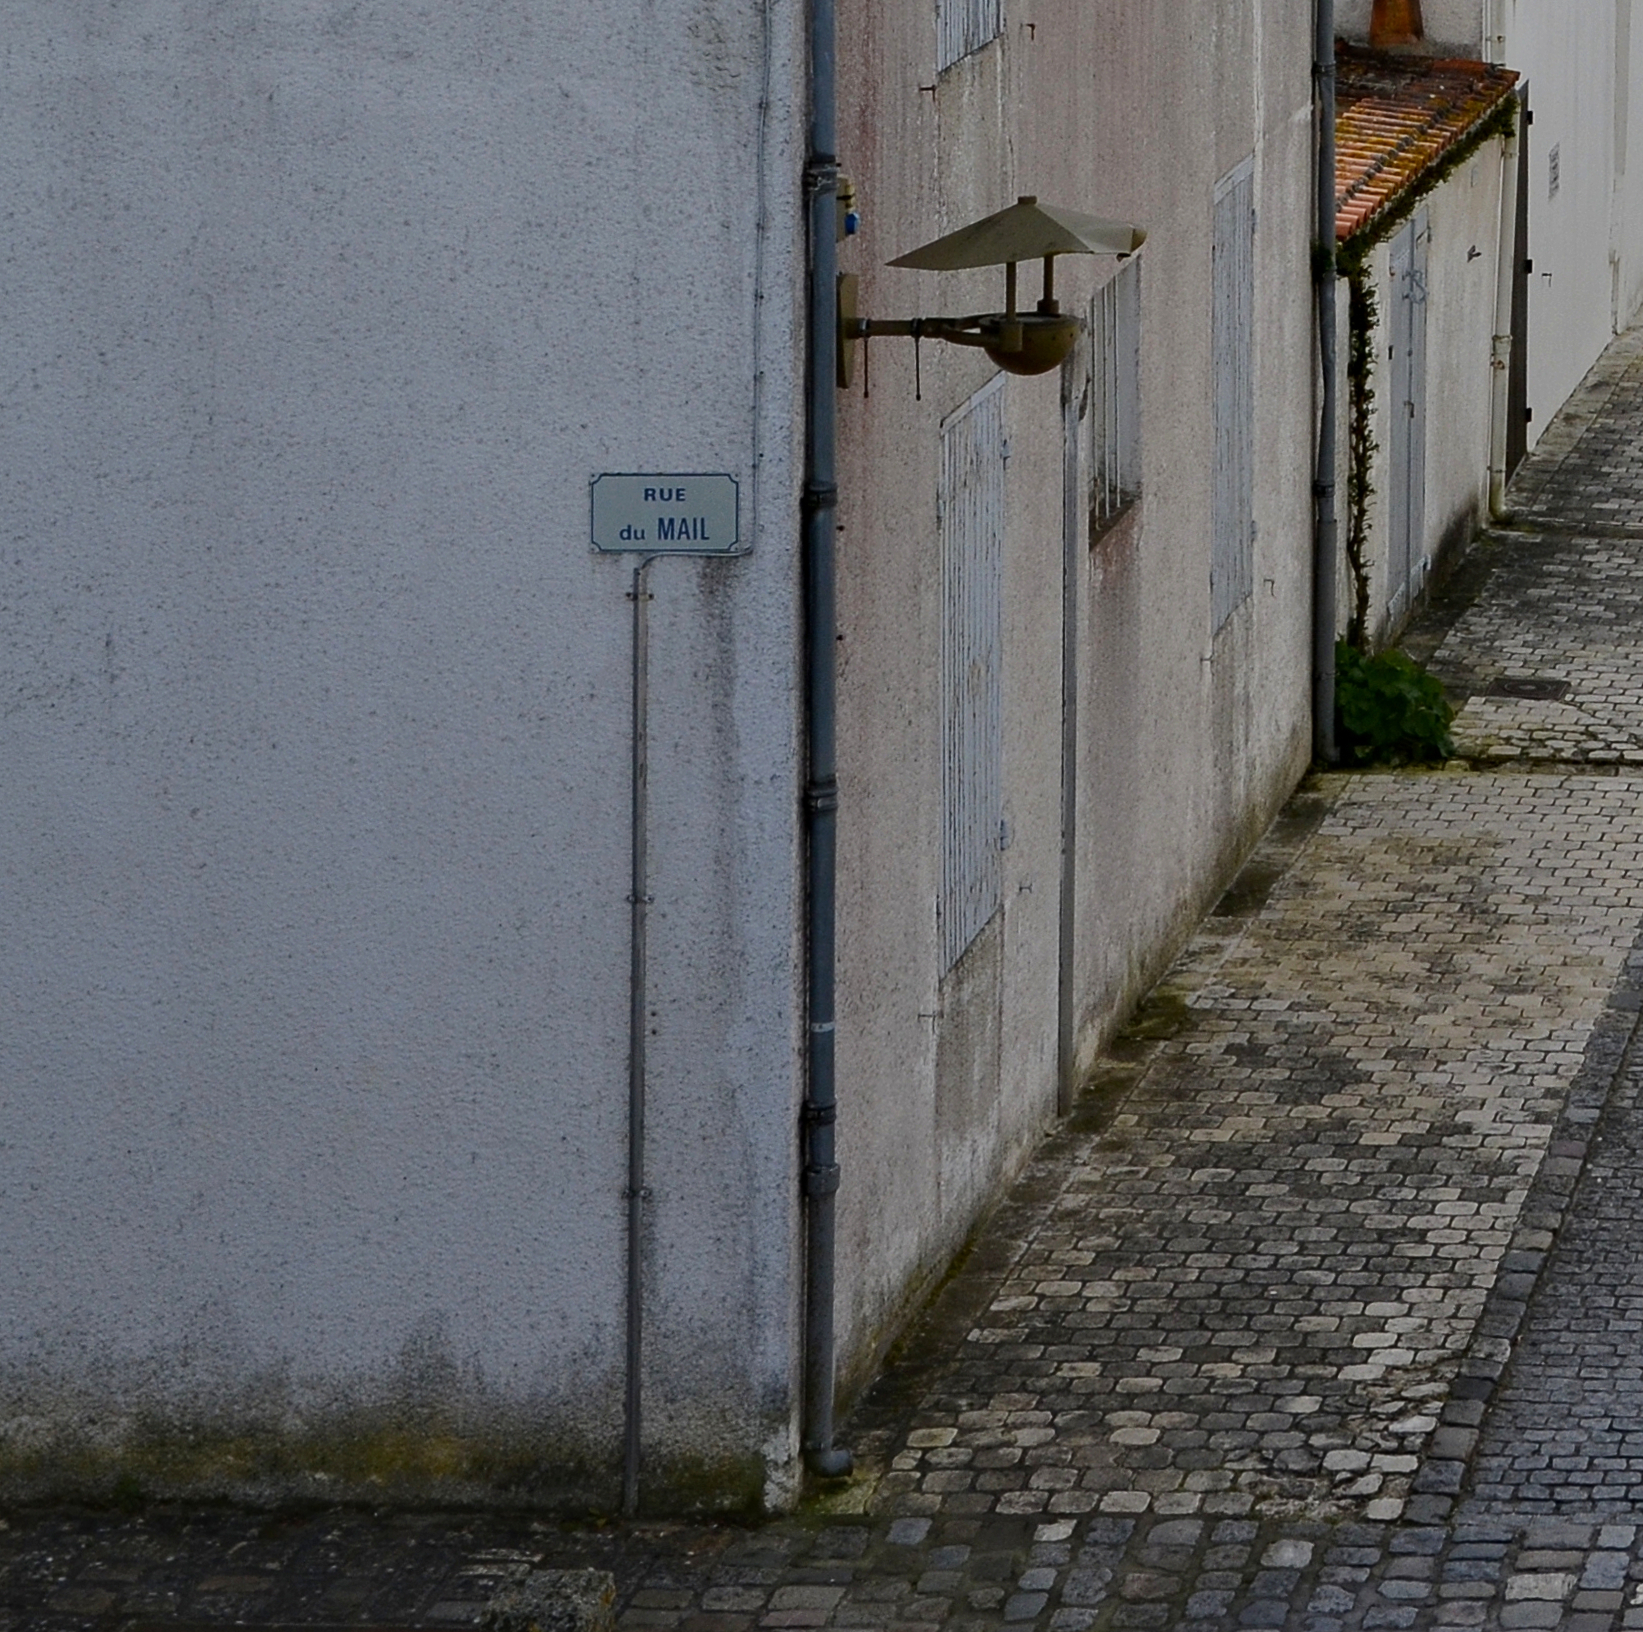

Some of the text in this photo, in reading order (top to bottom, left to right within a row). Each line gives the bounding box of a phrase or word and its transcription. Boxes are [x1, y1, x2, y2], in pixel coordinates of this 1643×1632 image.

[644, 488, 686, 501] RUE
[619, 517, 710, 541] du MAIL
